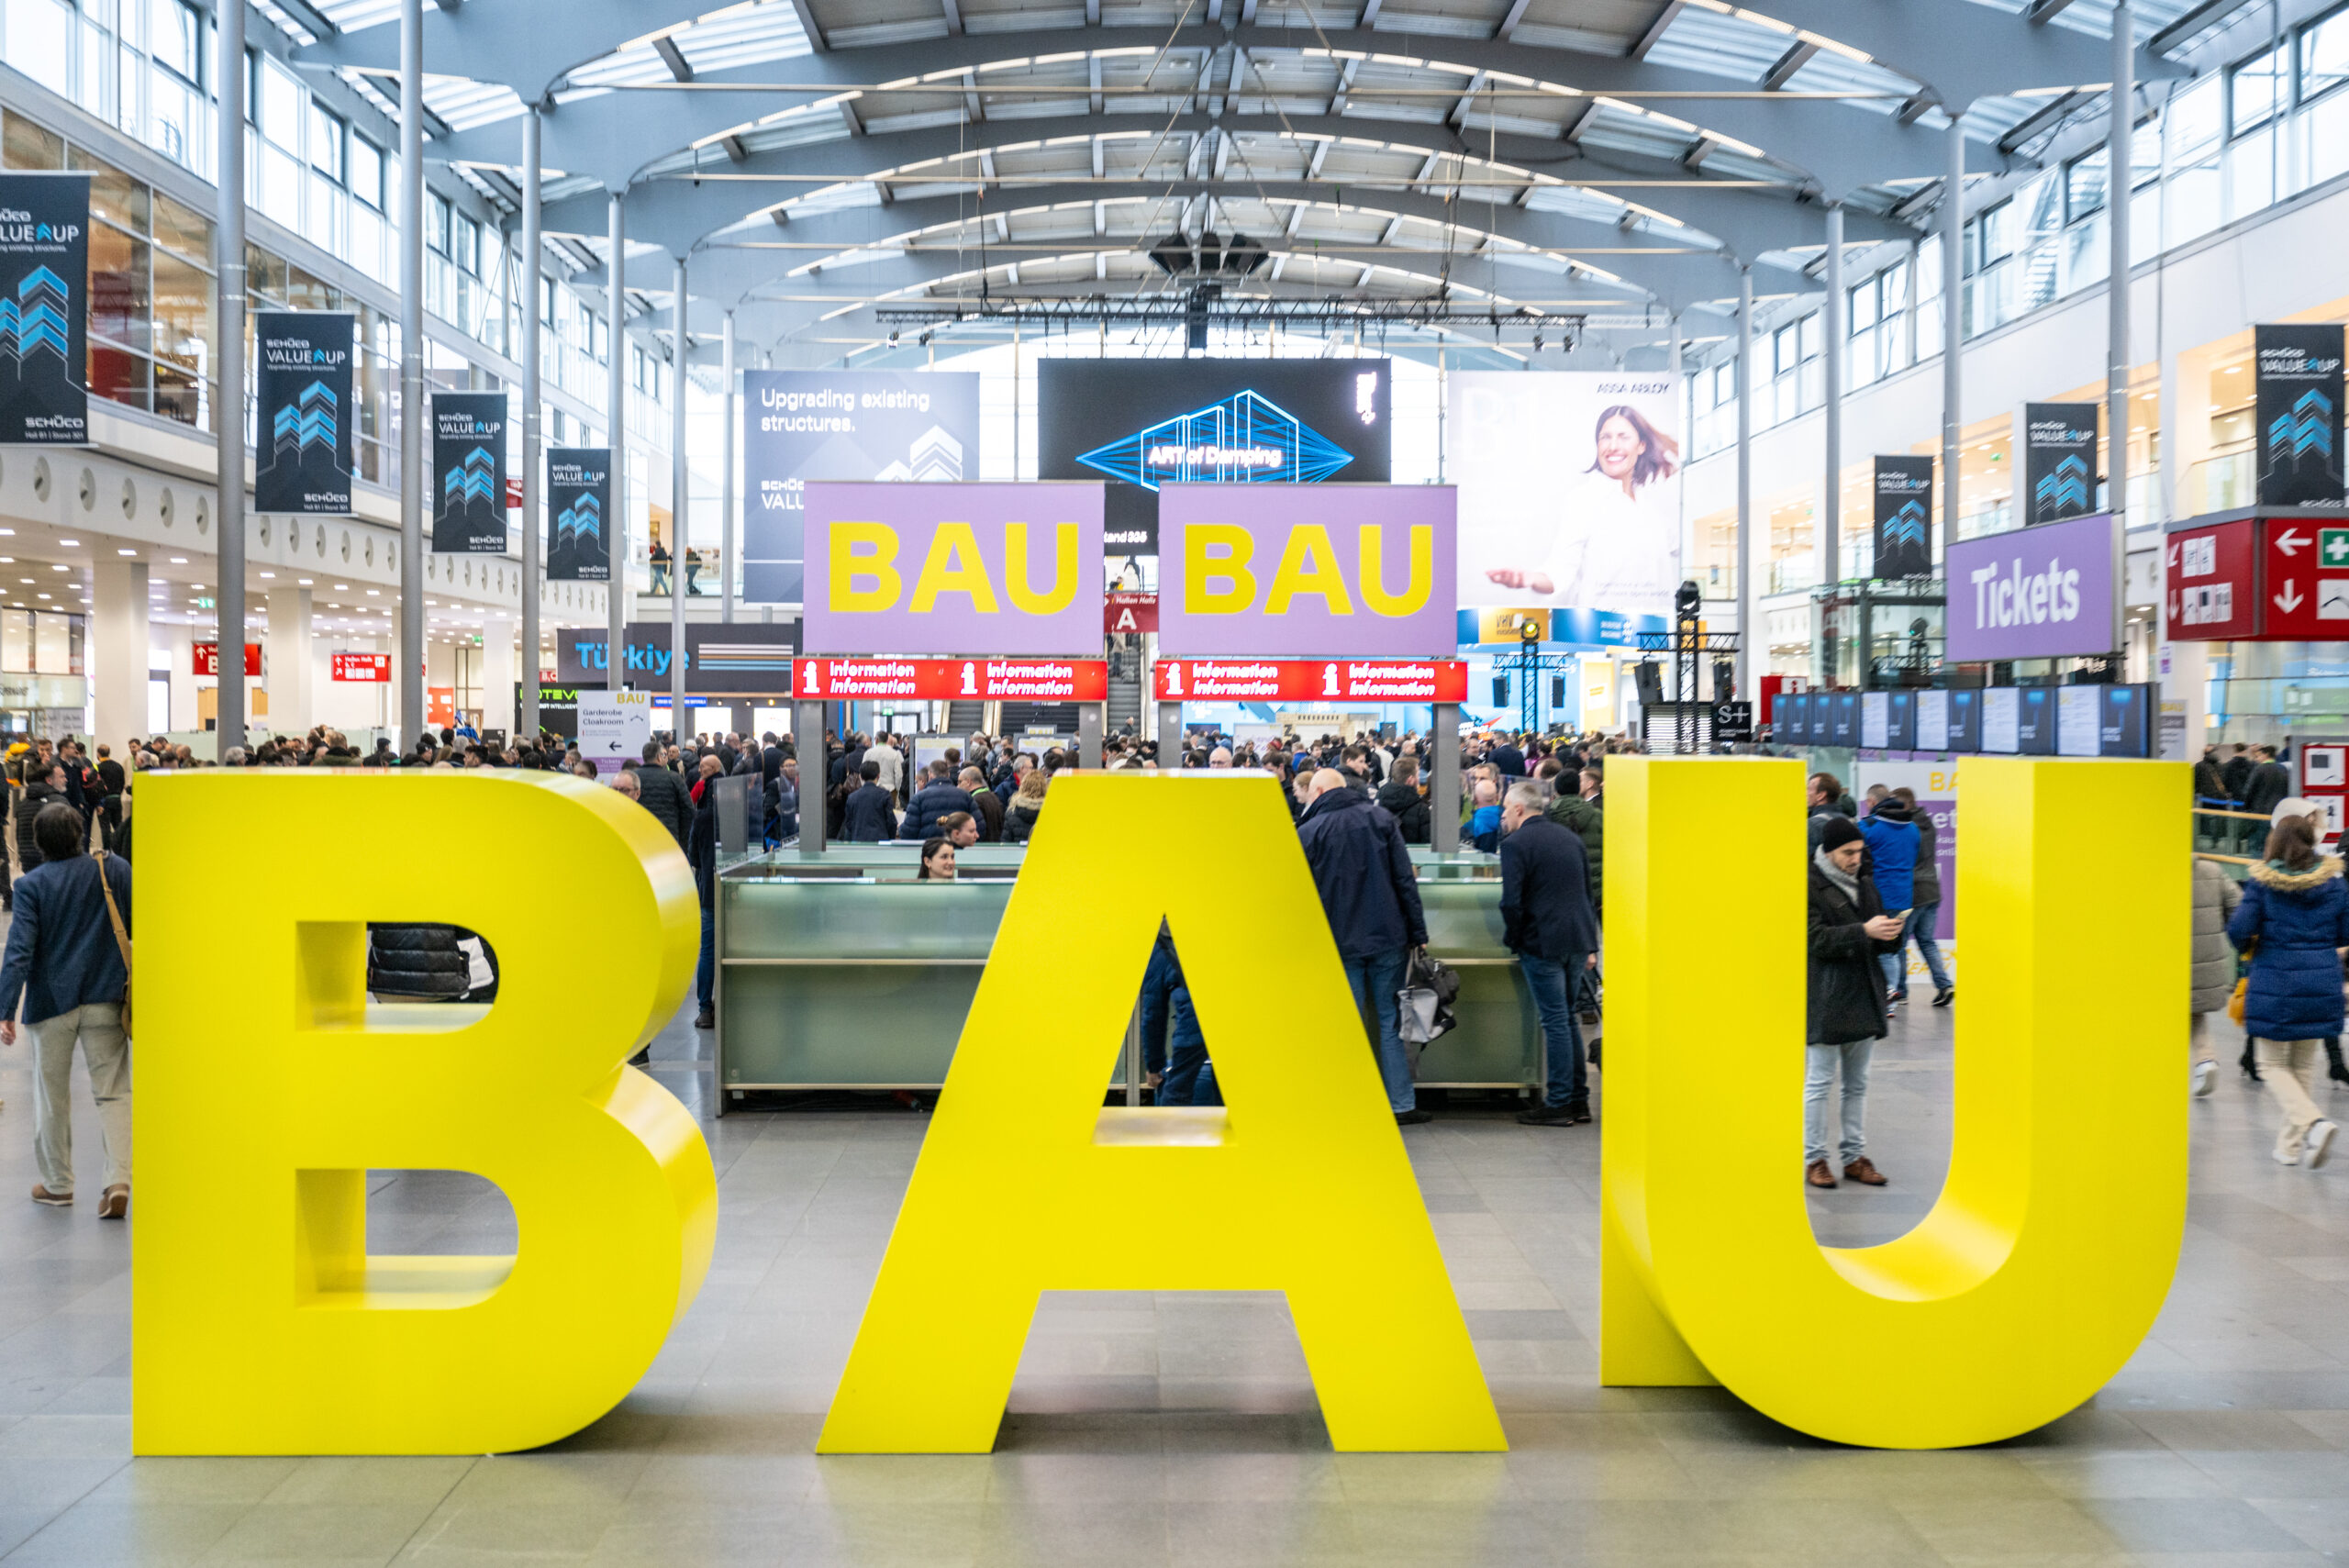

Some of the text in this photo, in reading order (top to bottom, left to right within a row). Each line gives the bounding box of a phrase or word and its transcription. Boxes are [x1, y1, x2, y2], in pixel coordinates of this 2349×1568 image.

[0, 224, 79, 243] LUE UP
[266, 349, 346, 364] VALUE UP
[762, 388, 930, 412] Upgrading existing
[25, 414, 83, 428] SCHÜCO
[439, 422, 501, 434] VALUE UP
[762, 415, 856, 432] structures.
[1149, 446, 1282, 468] ART of Damping
[552, 472, 606, 482] VALUE UP
[761, 478, 805, 491] SCHÜC
[304, 492, 348, 503] SCHÜCO
[761, 493, 805, 510] VALU
[1104, 531, 1127, 543] tand
[829, 521, 1079, 616] BAU
[1185, 524, 1433, 617] BAU
[1971, 557, 2080, 630] Tickets
[1116, 607, 1137, 629] A
[575, 642, 690, 676] Tükiy
[829, 660, 915, 677] Information
[986, 661, 1073, 678] Information
[1193, 662, 1278, 678] Information
[1349, 662, 1435, 679] Information
[829, 677, 916, 694] Information
[986, 678, 1074, 695] Information
[1193, 678, 1278, 695] Information
[1349, 679, 1436, 695] Information
[617, 693, 645, 705] BAU
[583, 708, 622, 717] Garderobe
[1718, 705, 1750, 724] S+
[1930, 772, 1957, 792] BA
[132, 755, 2193, 1455] BAU
